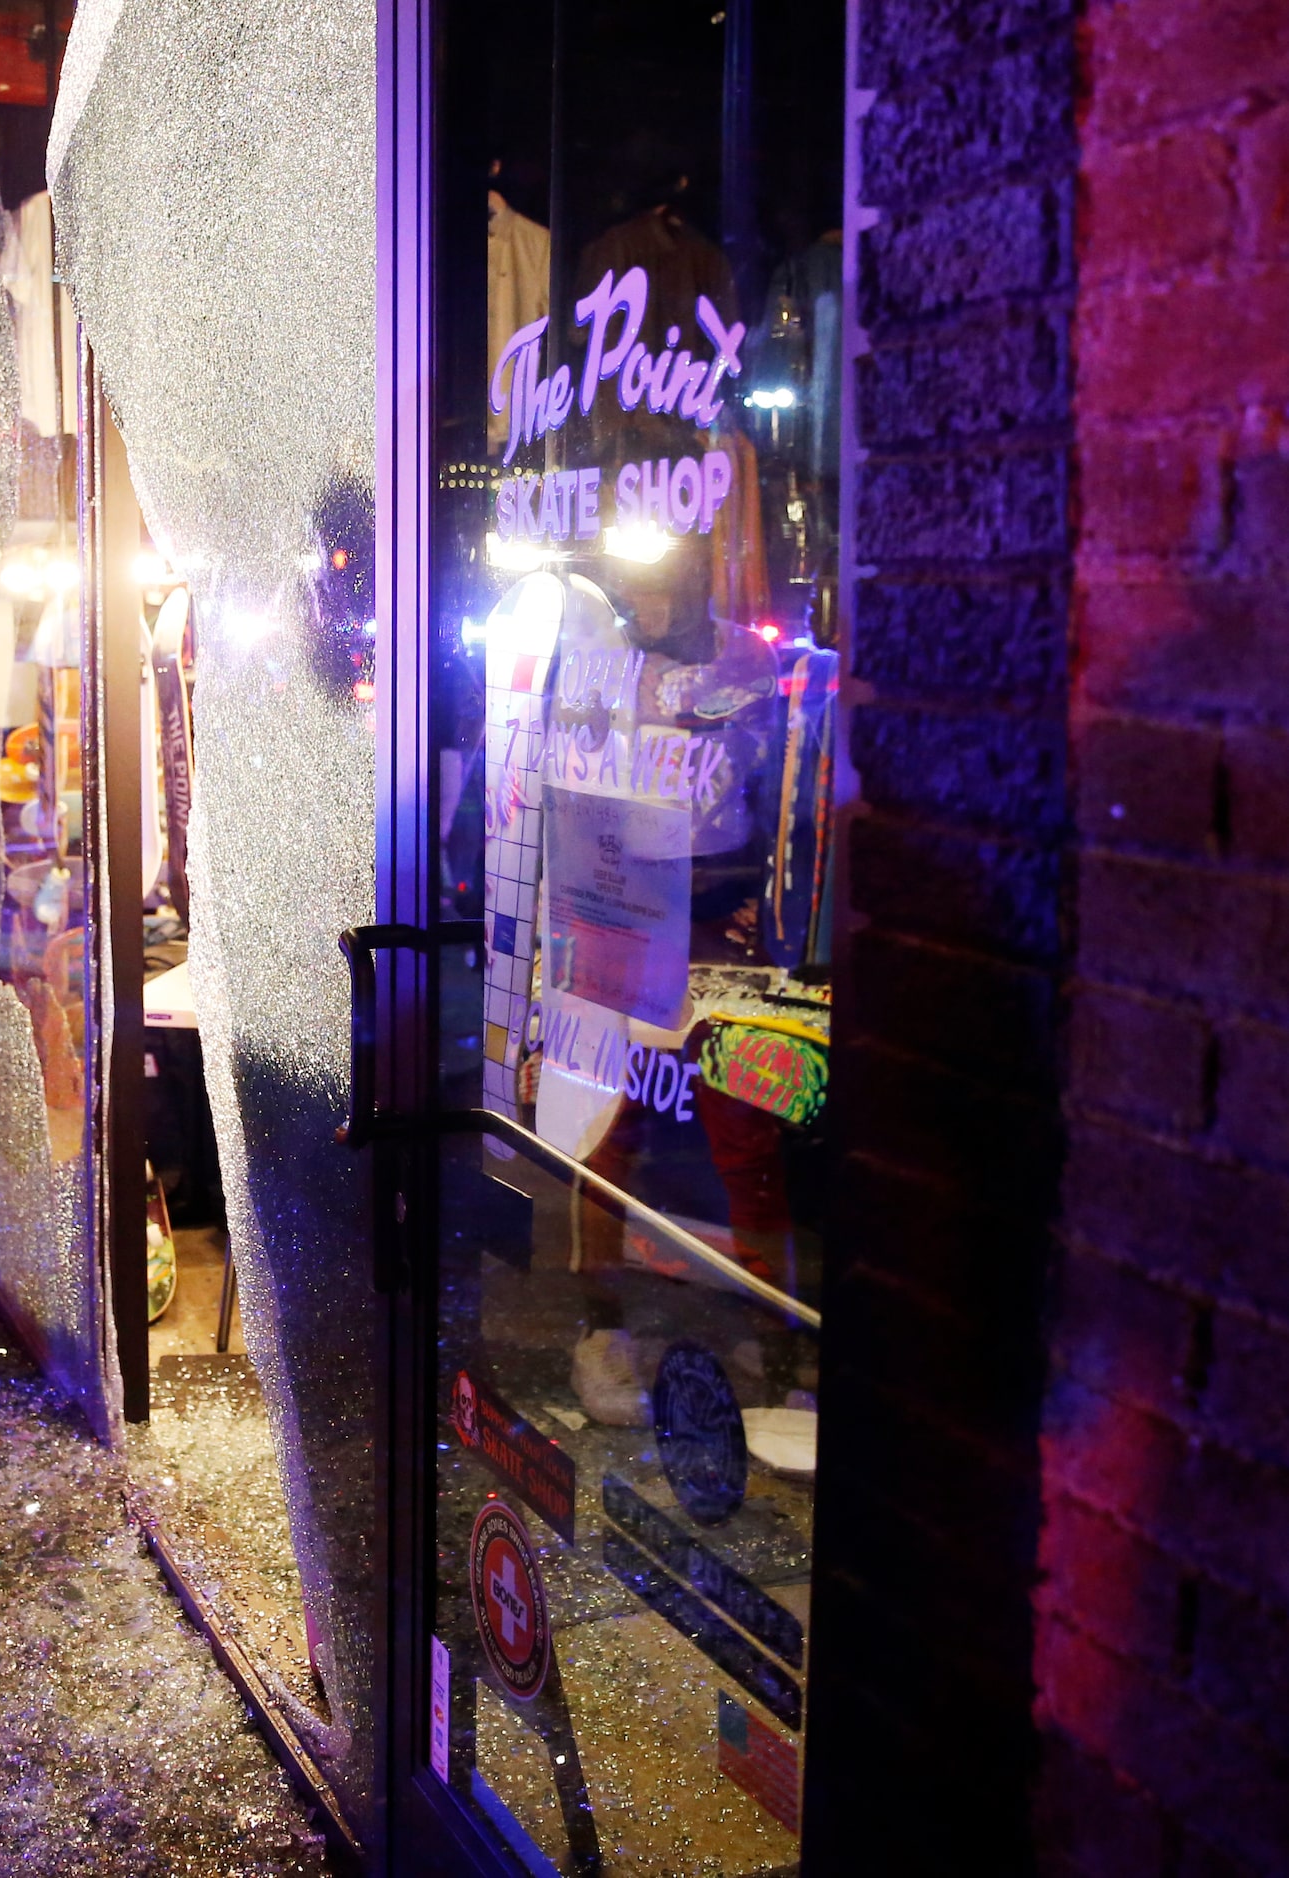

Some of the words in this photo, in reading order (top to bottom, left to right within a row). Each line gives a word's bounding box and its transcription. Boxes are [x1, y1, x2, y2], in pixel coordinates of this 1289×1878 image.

[489, 315, 574, 467] The
[574, 266, 747, 429] Point
[496, 466, 601, 544] SKATE
[615, 450, 731, 537] SHOP
[561, 648, 645, 710] OPEN
[167, 706, 185, 753] THE
[504, 718, 520, 771] 7
[527, 719, 592, 782] DAYS
[599, 728, 620, 788] A
[630, 730, 726, 802] WEEK
[510, 994, 581, 1071] BOWL
[592, 1027, 701, 1122] INSIDE
[727, 1059, 796, 1113] BALLS
[732, 1035, 806, 1089] SLIME
[482, 1425, 524, 1484] SKATE
[527, 1467, 571, 1519] SHOP
[487, 1517, 509, 1534] BONES
[492, 1579, 525, 1620] BONES
[479, 1606, 514, 1684] AUTHORIZED
[515, 1663, 538, 1684] DEALER
